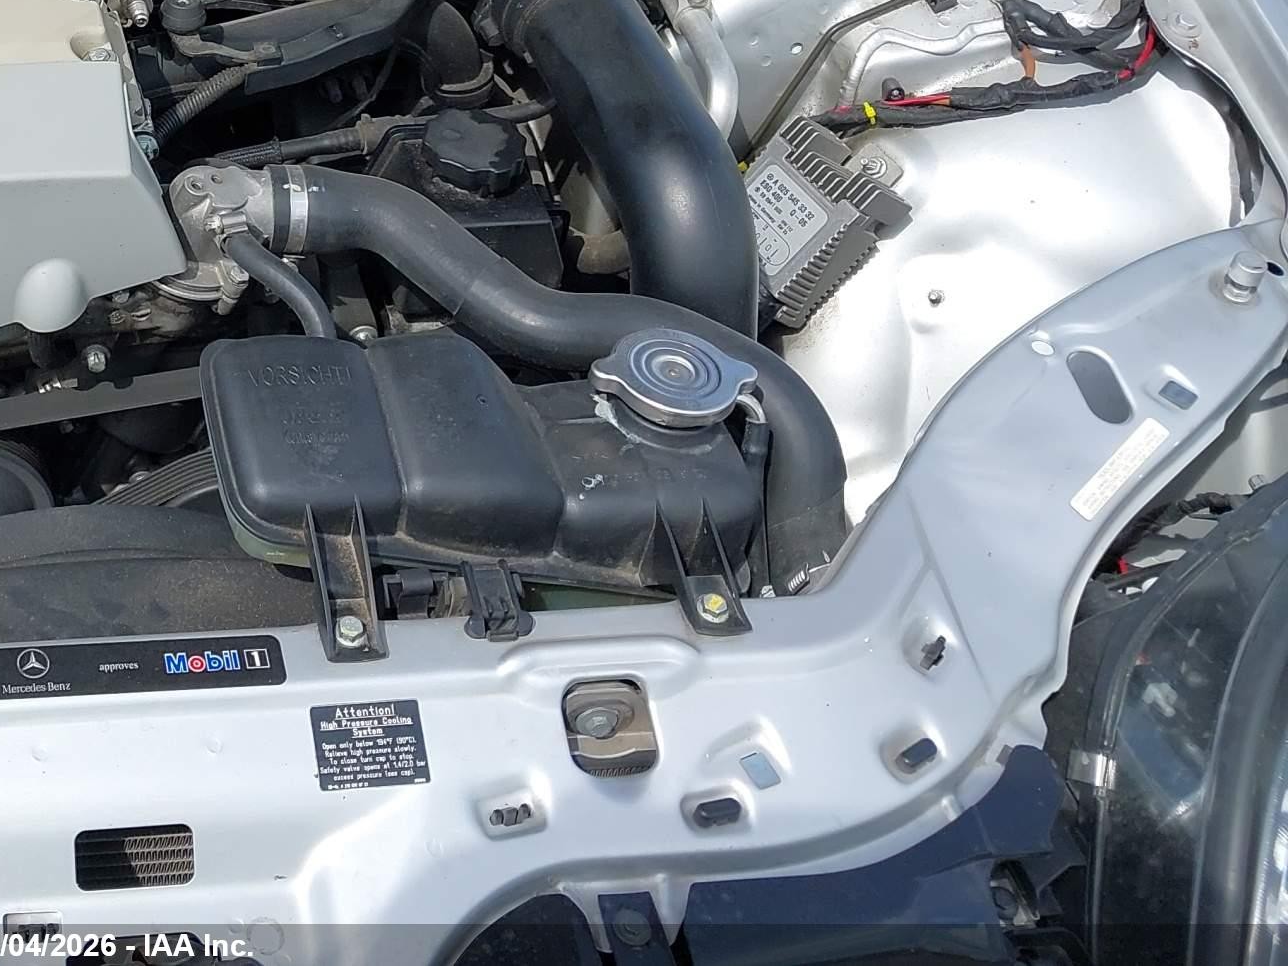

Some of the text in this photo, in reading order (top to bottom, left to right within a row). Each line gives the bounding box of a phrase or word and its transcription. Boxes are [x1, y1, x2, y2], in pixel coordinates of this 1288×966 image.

[99, 661, 139, 673] approves
[164, 650, 241, 674] Mobil
[2, 682, 71, 694] Mercedes Benz
[335, 704, 395, 719] Attention!
[320, 716, 412, 730] High Pressure Cooling
[353, 728, 383, 737] System
